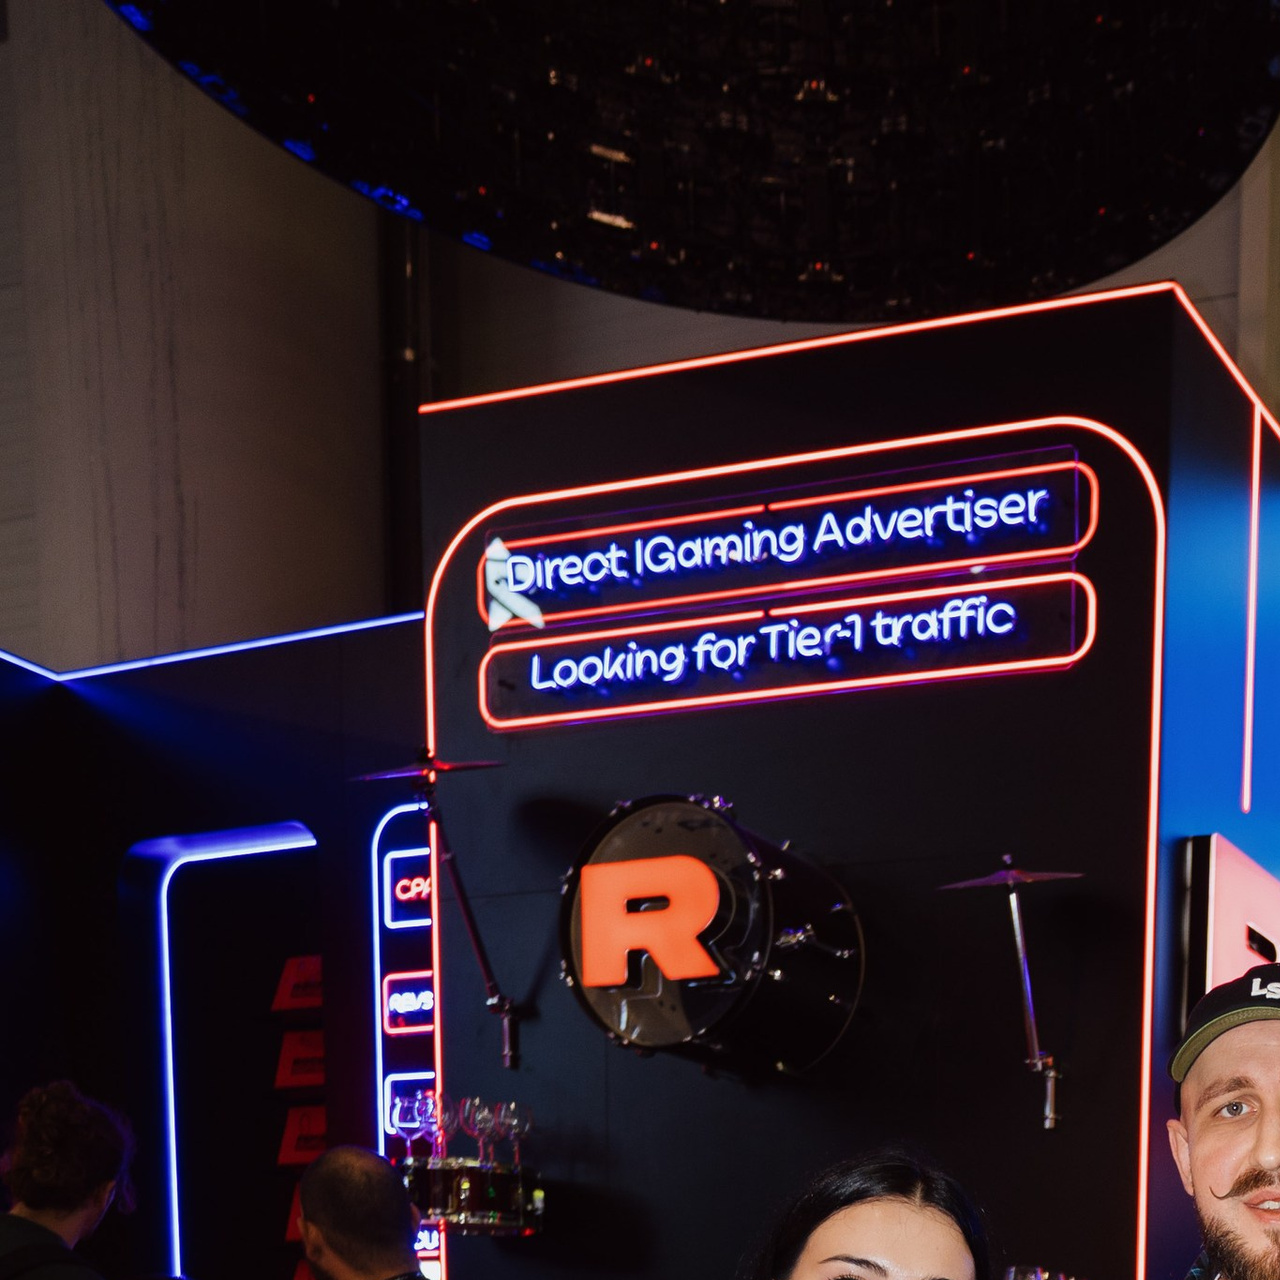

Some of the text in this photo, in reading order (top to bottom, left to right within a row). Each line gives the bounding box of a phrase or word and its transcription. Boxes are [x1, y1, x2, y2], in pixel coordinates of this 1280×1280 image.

[506, 542, 628, 594] Direct
[812, 488, 1050, 553] Advertiser
[530, 595, 1016, 690] Looking for Tier-1 traffic
[581, 855, 720, 987] R
